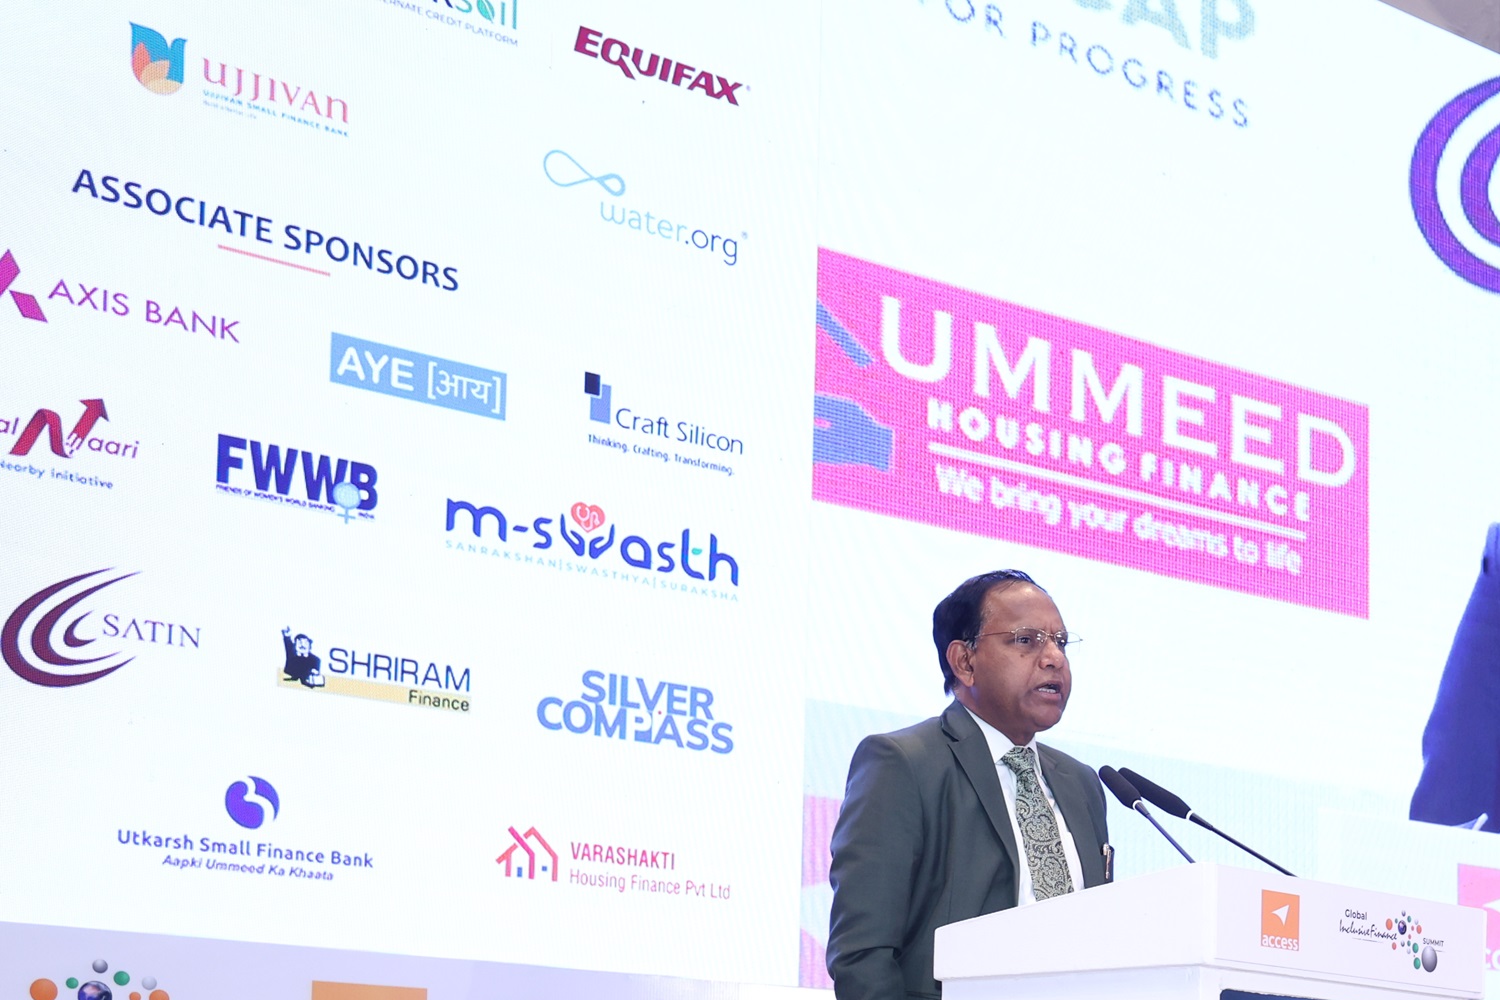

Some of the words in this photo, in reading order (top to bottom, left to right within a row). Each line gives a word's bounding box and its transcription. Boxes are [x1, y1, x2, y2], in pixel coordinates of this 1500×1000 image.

[425, 9, 462, 28] CREDIT
[465, 22, 518, 46] PLATFORM
[573, 25, 743, 106] EQUIFAX
[1030, 20, 1248, 128] PROGRESS
[72, 169, 273, 244] ASSOCIATE
[284, 225, 459, 291] SPONSORS
[600, 201, 738, 265] water.org
[48, 279, 130, 316] AXIS
[145, 300, 240, 343] BANK
[337, 346, 414, 391] AYE
[880, 295, 1357, 489] UMMEED
[615, 408, 669, 438] Craft
[676, 421, 743, 455] Silicon
[216, 433, 378, 511] FWWB
[927, 398, 1127, 476] HOUSING
[1140, 451, 1311, 522] FINANCE
[935, 464, 983, 502] We
[989, 476, 1062, 525] bring
[1067, 500, 1128, 532] your
[1132, 512, 1228, 557] dreams
[1233, 537, 1259, 565] to
[102, 613, 201, 649] SATIN
[328, 648, 471, 693] SHRIRAM
[409, 689, 469, 712] Finance
[581, 670, 714, 720] SILVER
[536, 696, 734, 755] COMPASS
[117, 829, 194, 852] Utkarsh
[200, 837, 251, 857] Small
[256, 842, 325, 864] Finance
[331, 850, 374, 868] Bank
[162, 854, 202, 871] Aapki
[268, 863, 286, 877] Ka
[289, 866, 334, 881] Khaata
[570, 841, 675, 870] VARASHAKTI
[569, 868, 626, 893] Housing
[631, 875, 680, 895] Finance
[685, 880, 705, 898] Pvt
[710, 883, 731, 901] Ltd
[1345, 908, 1367, 920] Global
[1262, 934, 1298, 951] access
[1422, 937, 1445, 947] SUMMIT
